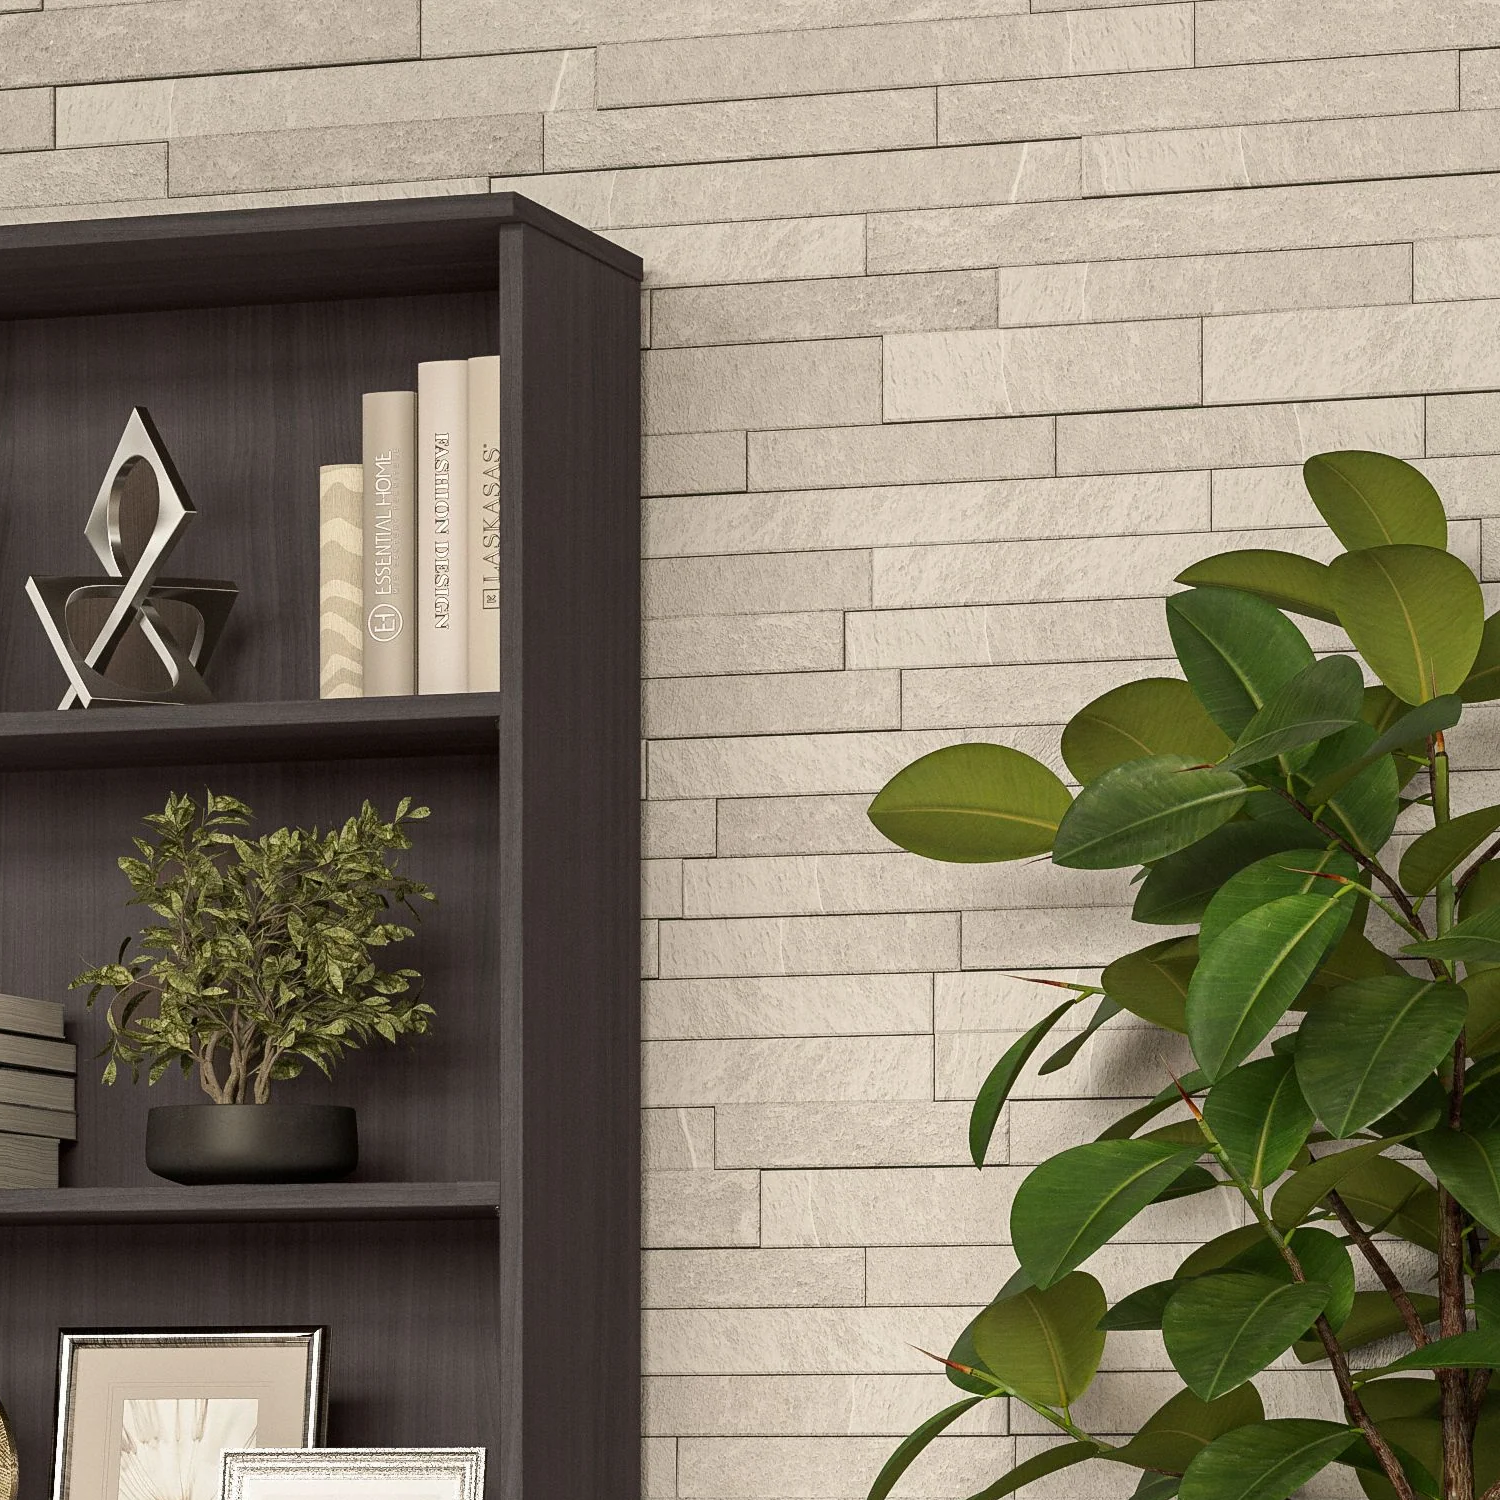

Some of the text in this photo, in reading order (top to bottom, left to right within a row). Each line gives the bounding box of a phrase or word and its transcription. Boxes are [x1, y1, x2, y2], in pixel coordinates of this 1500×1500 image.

[374, 450, 393, 596] ESSENTIAL HOME
[434, 432, 450, 629] FASHION DESIGN
[482, 447, 501, 583] LASKASAS
